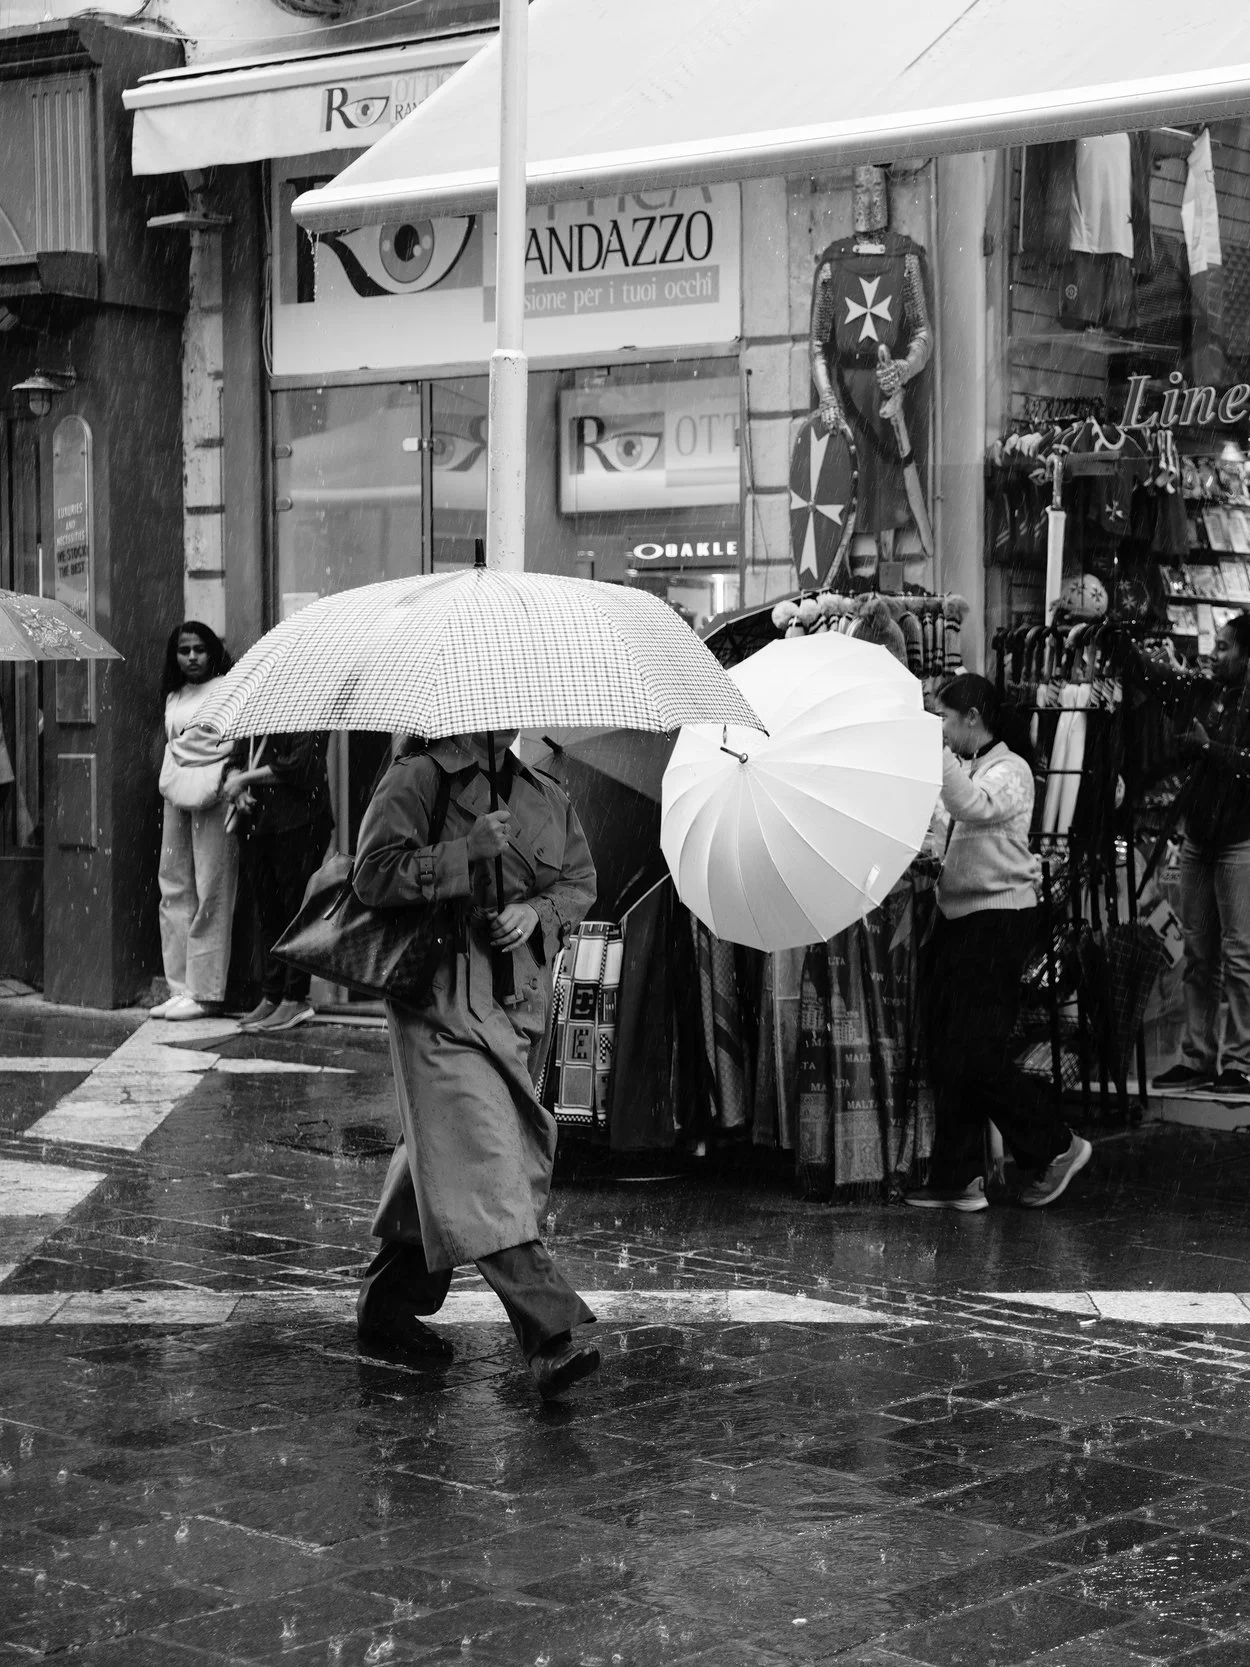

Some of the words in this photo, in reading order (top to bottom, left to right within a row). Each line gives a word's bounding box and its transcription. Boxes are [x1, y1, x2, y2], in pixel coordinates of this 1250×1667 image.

[525, 210, 714, 276] ANDAZZO
[523, 289, 567, 313] sione
[574, 287, 603, 313] per
[609, 281, 615, 304] i
[622, 277, 657, 304] tuoi
[664, 272, 713, 300] occhi
